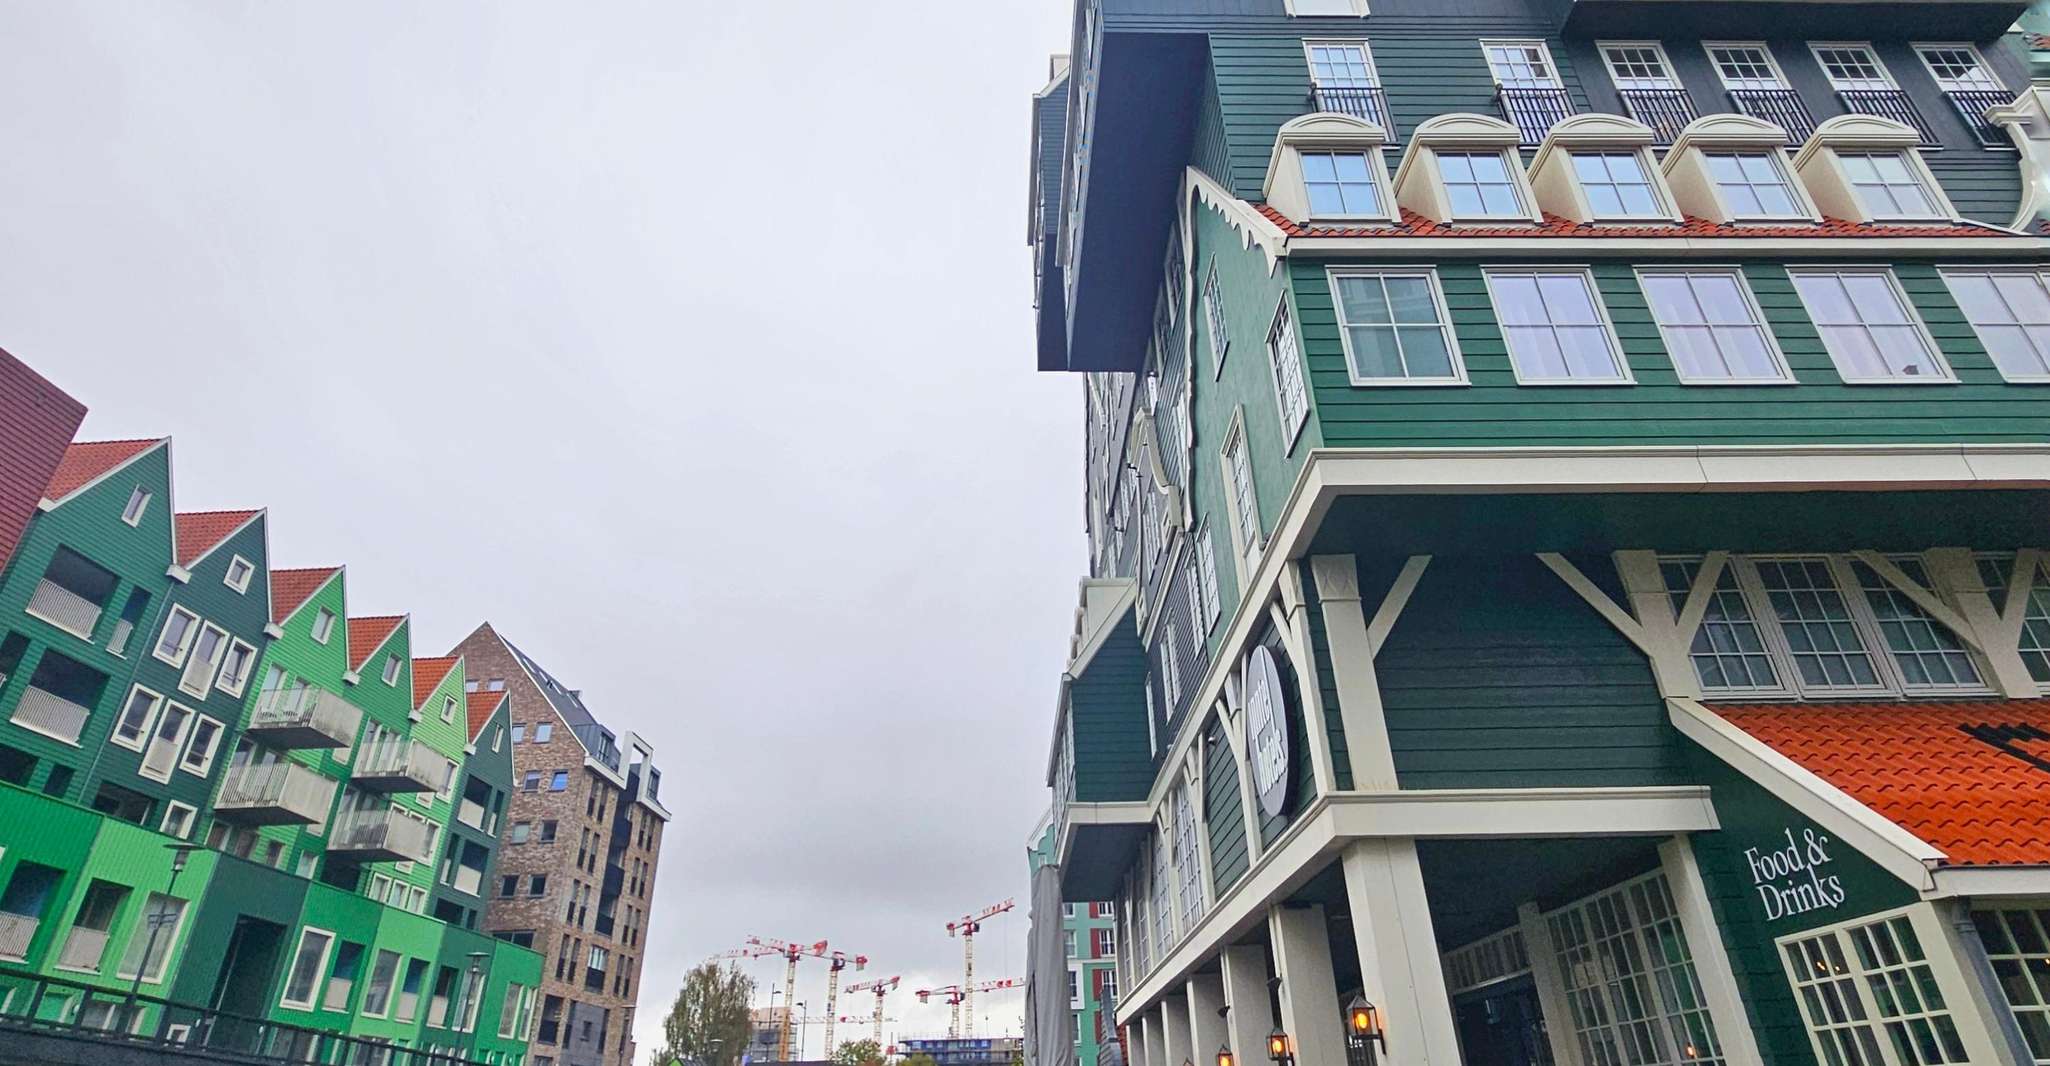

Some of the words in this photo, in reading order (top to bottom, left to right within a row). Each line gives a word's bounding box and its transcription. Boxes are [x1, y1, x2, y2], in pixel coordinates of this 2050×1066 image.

[1744, 827, 1806, 884] Food
[1803, 828, 1833, 865] &
[1756, 862, 1845, 921] Drinks
